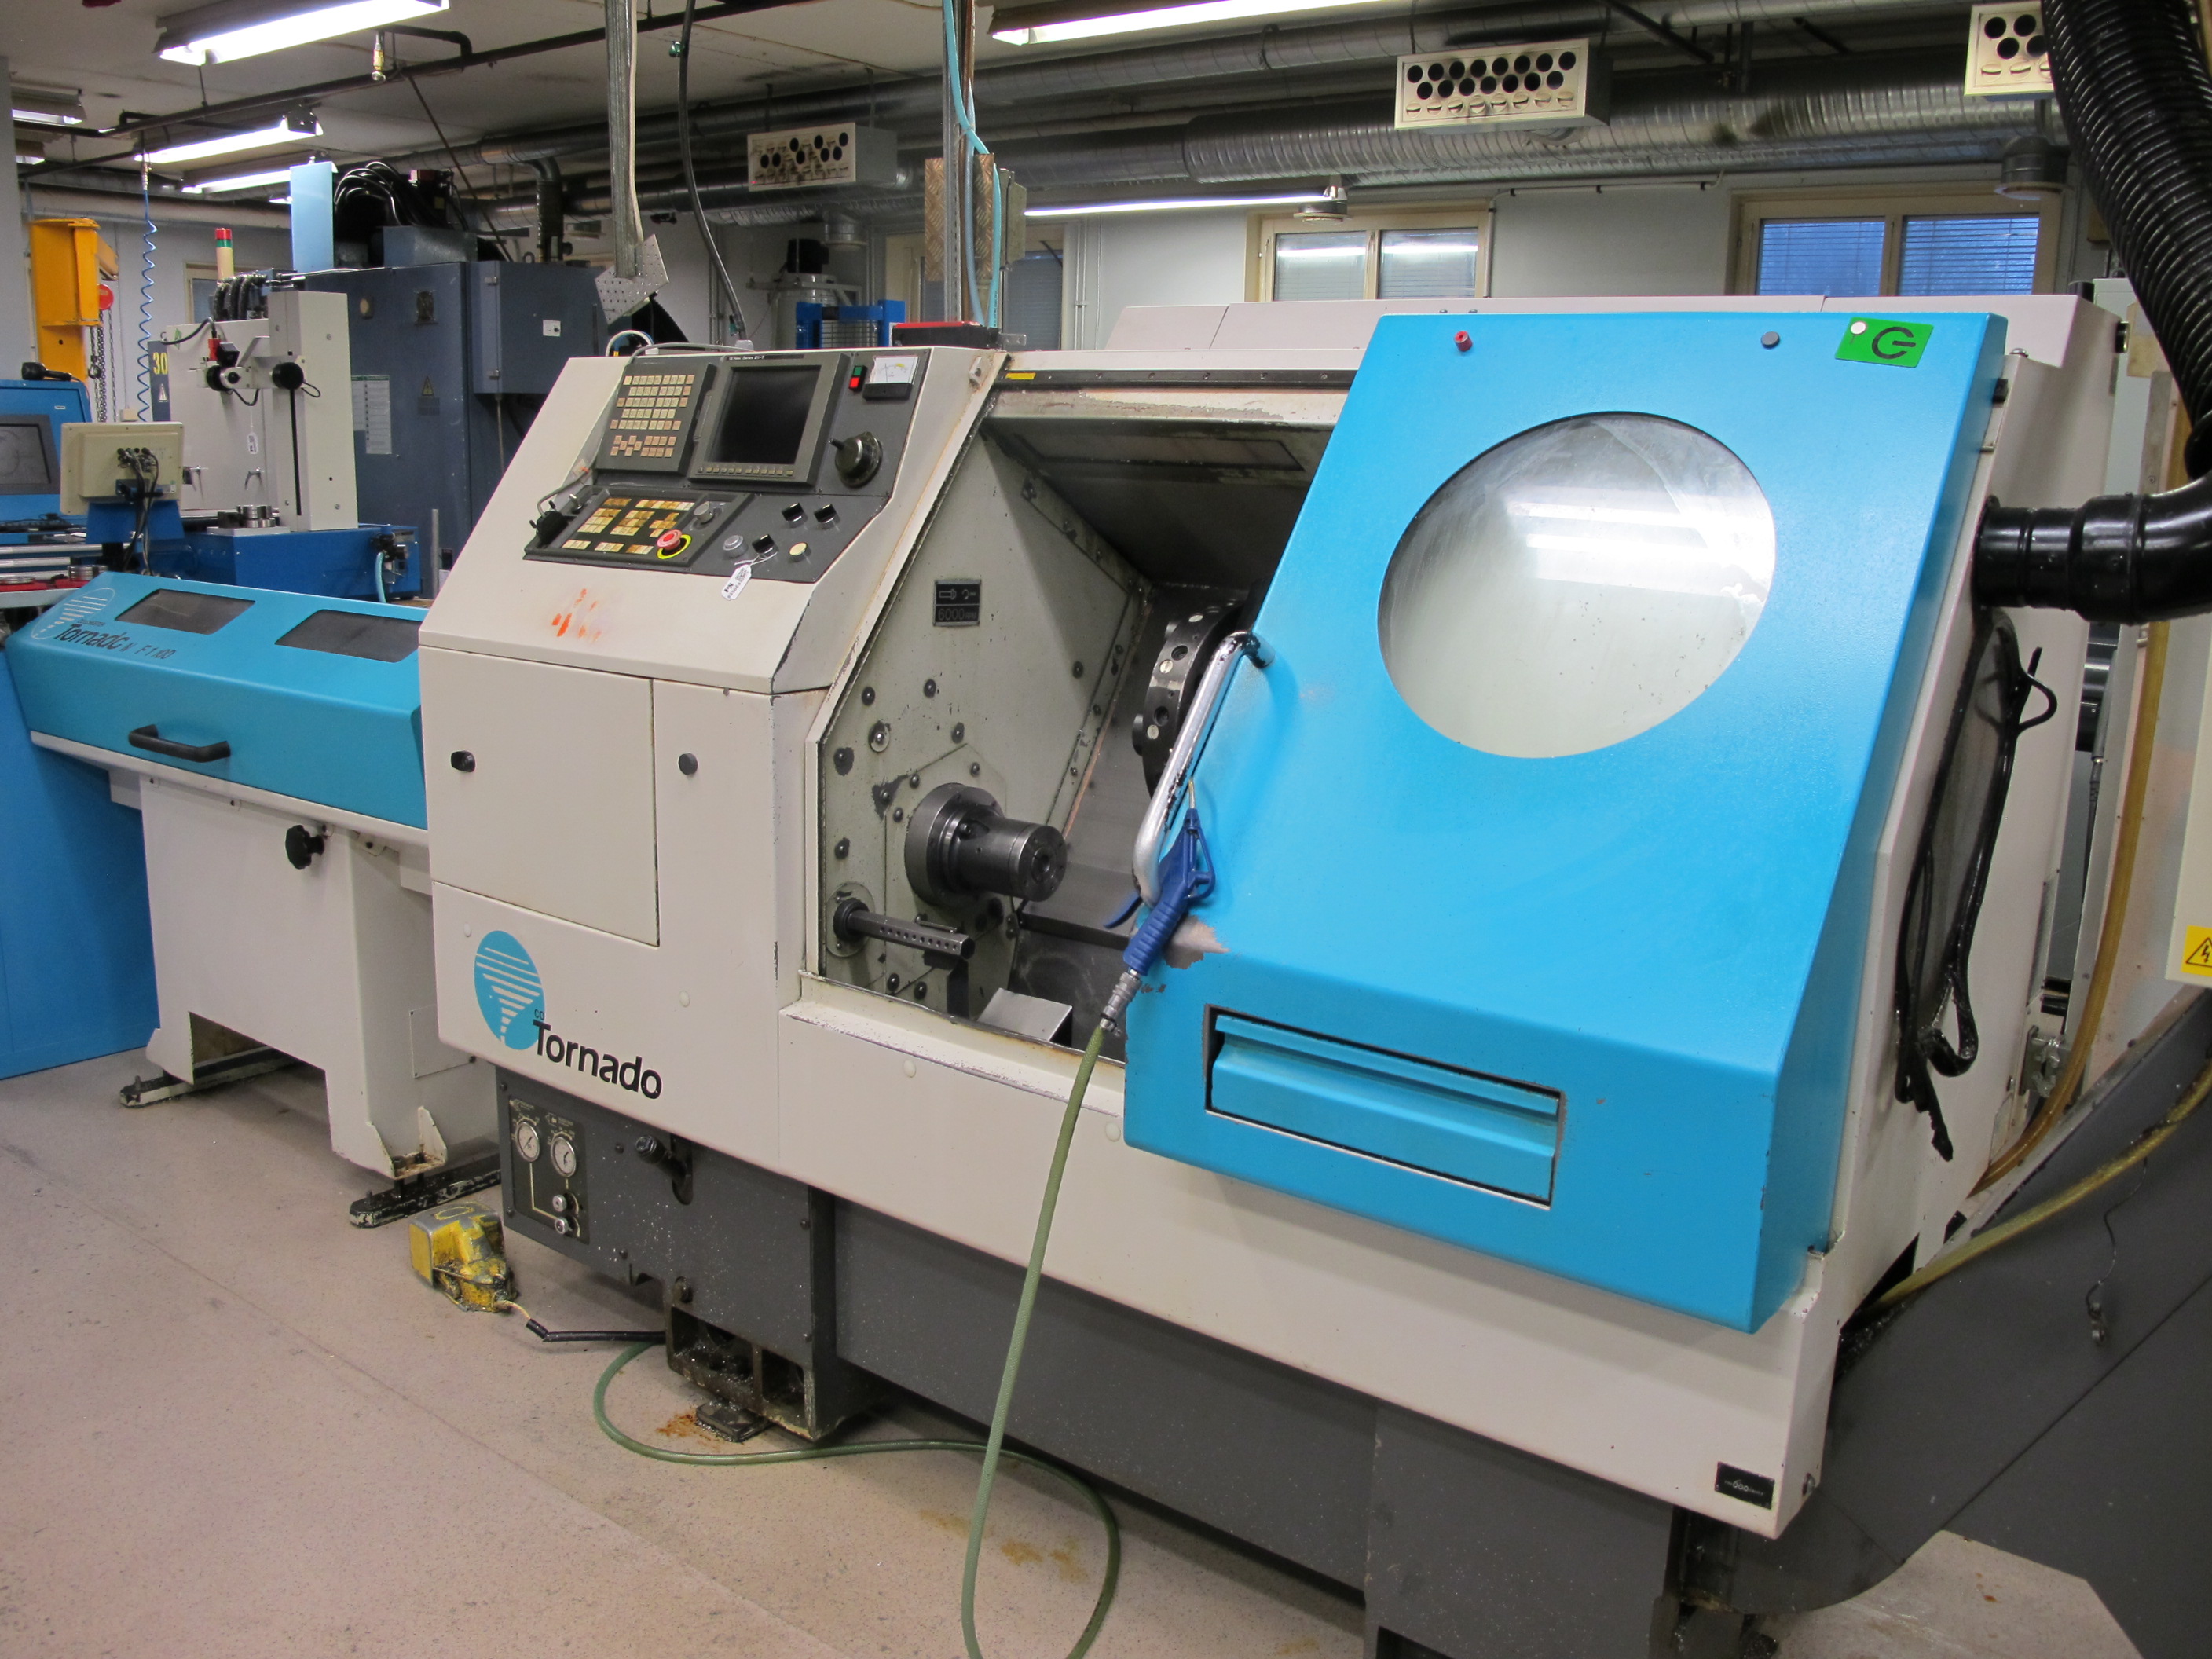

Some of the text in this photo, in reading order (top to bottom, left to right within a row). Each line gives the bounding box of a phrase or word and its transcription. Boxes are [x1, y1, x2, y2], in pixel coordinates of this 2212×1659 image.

[152, 352, 168, 375] 30
[938, 608, 965, 621] 6000
[533, 1019, 662, 1100] Tornado
